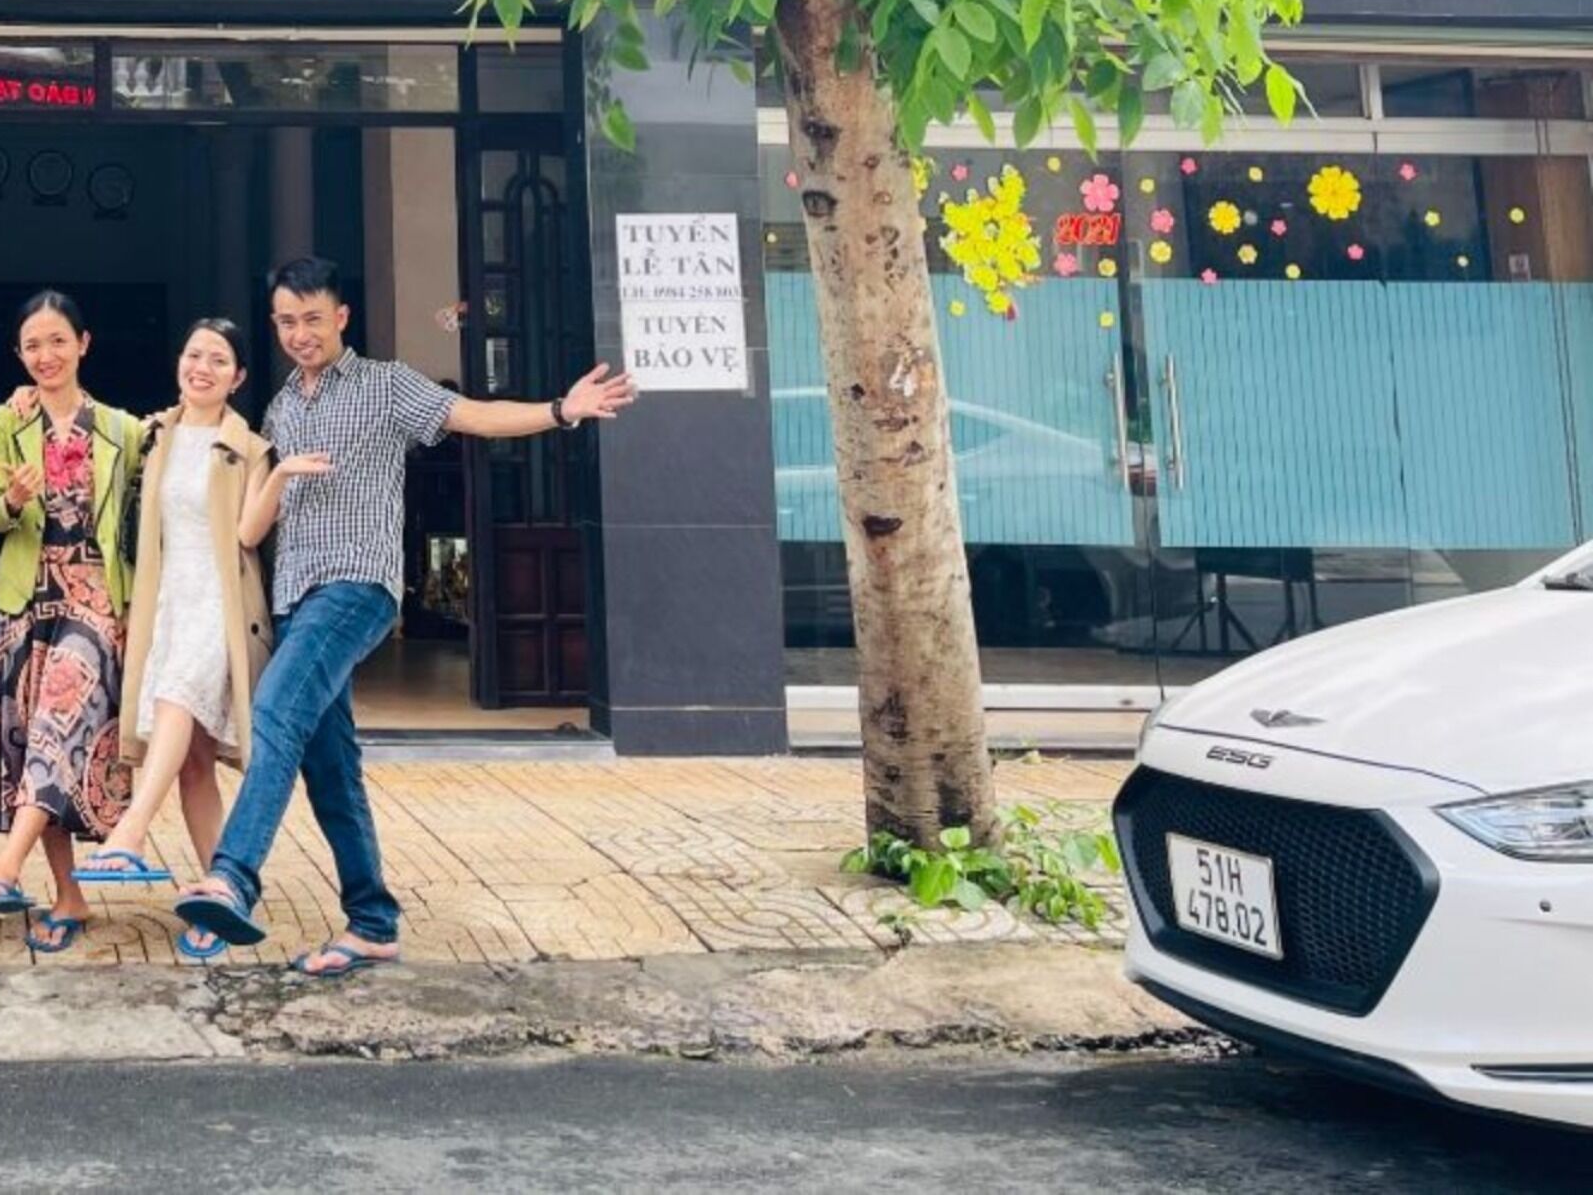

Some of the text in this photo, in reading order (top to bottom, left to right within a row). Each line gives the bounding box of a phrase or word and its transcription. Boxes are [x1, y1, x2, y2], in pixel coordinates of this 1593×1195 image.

[1054, 212, 1122, 246] 2021
[1196, 847, 1244, 896] 51H
[1188, 887, 1268, 947] 478.02
